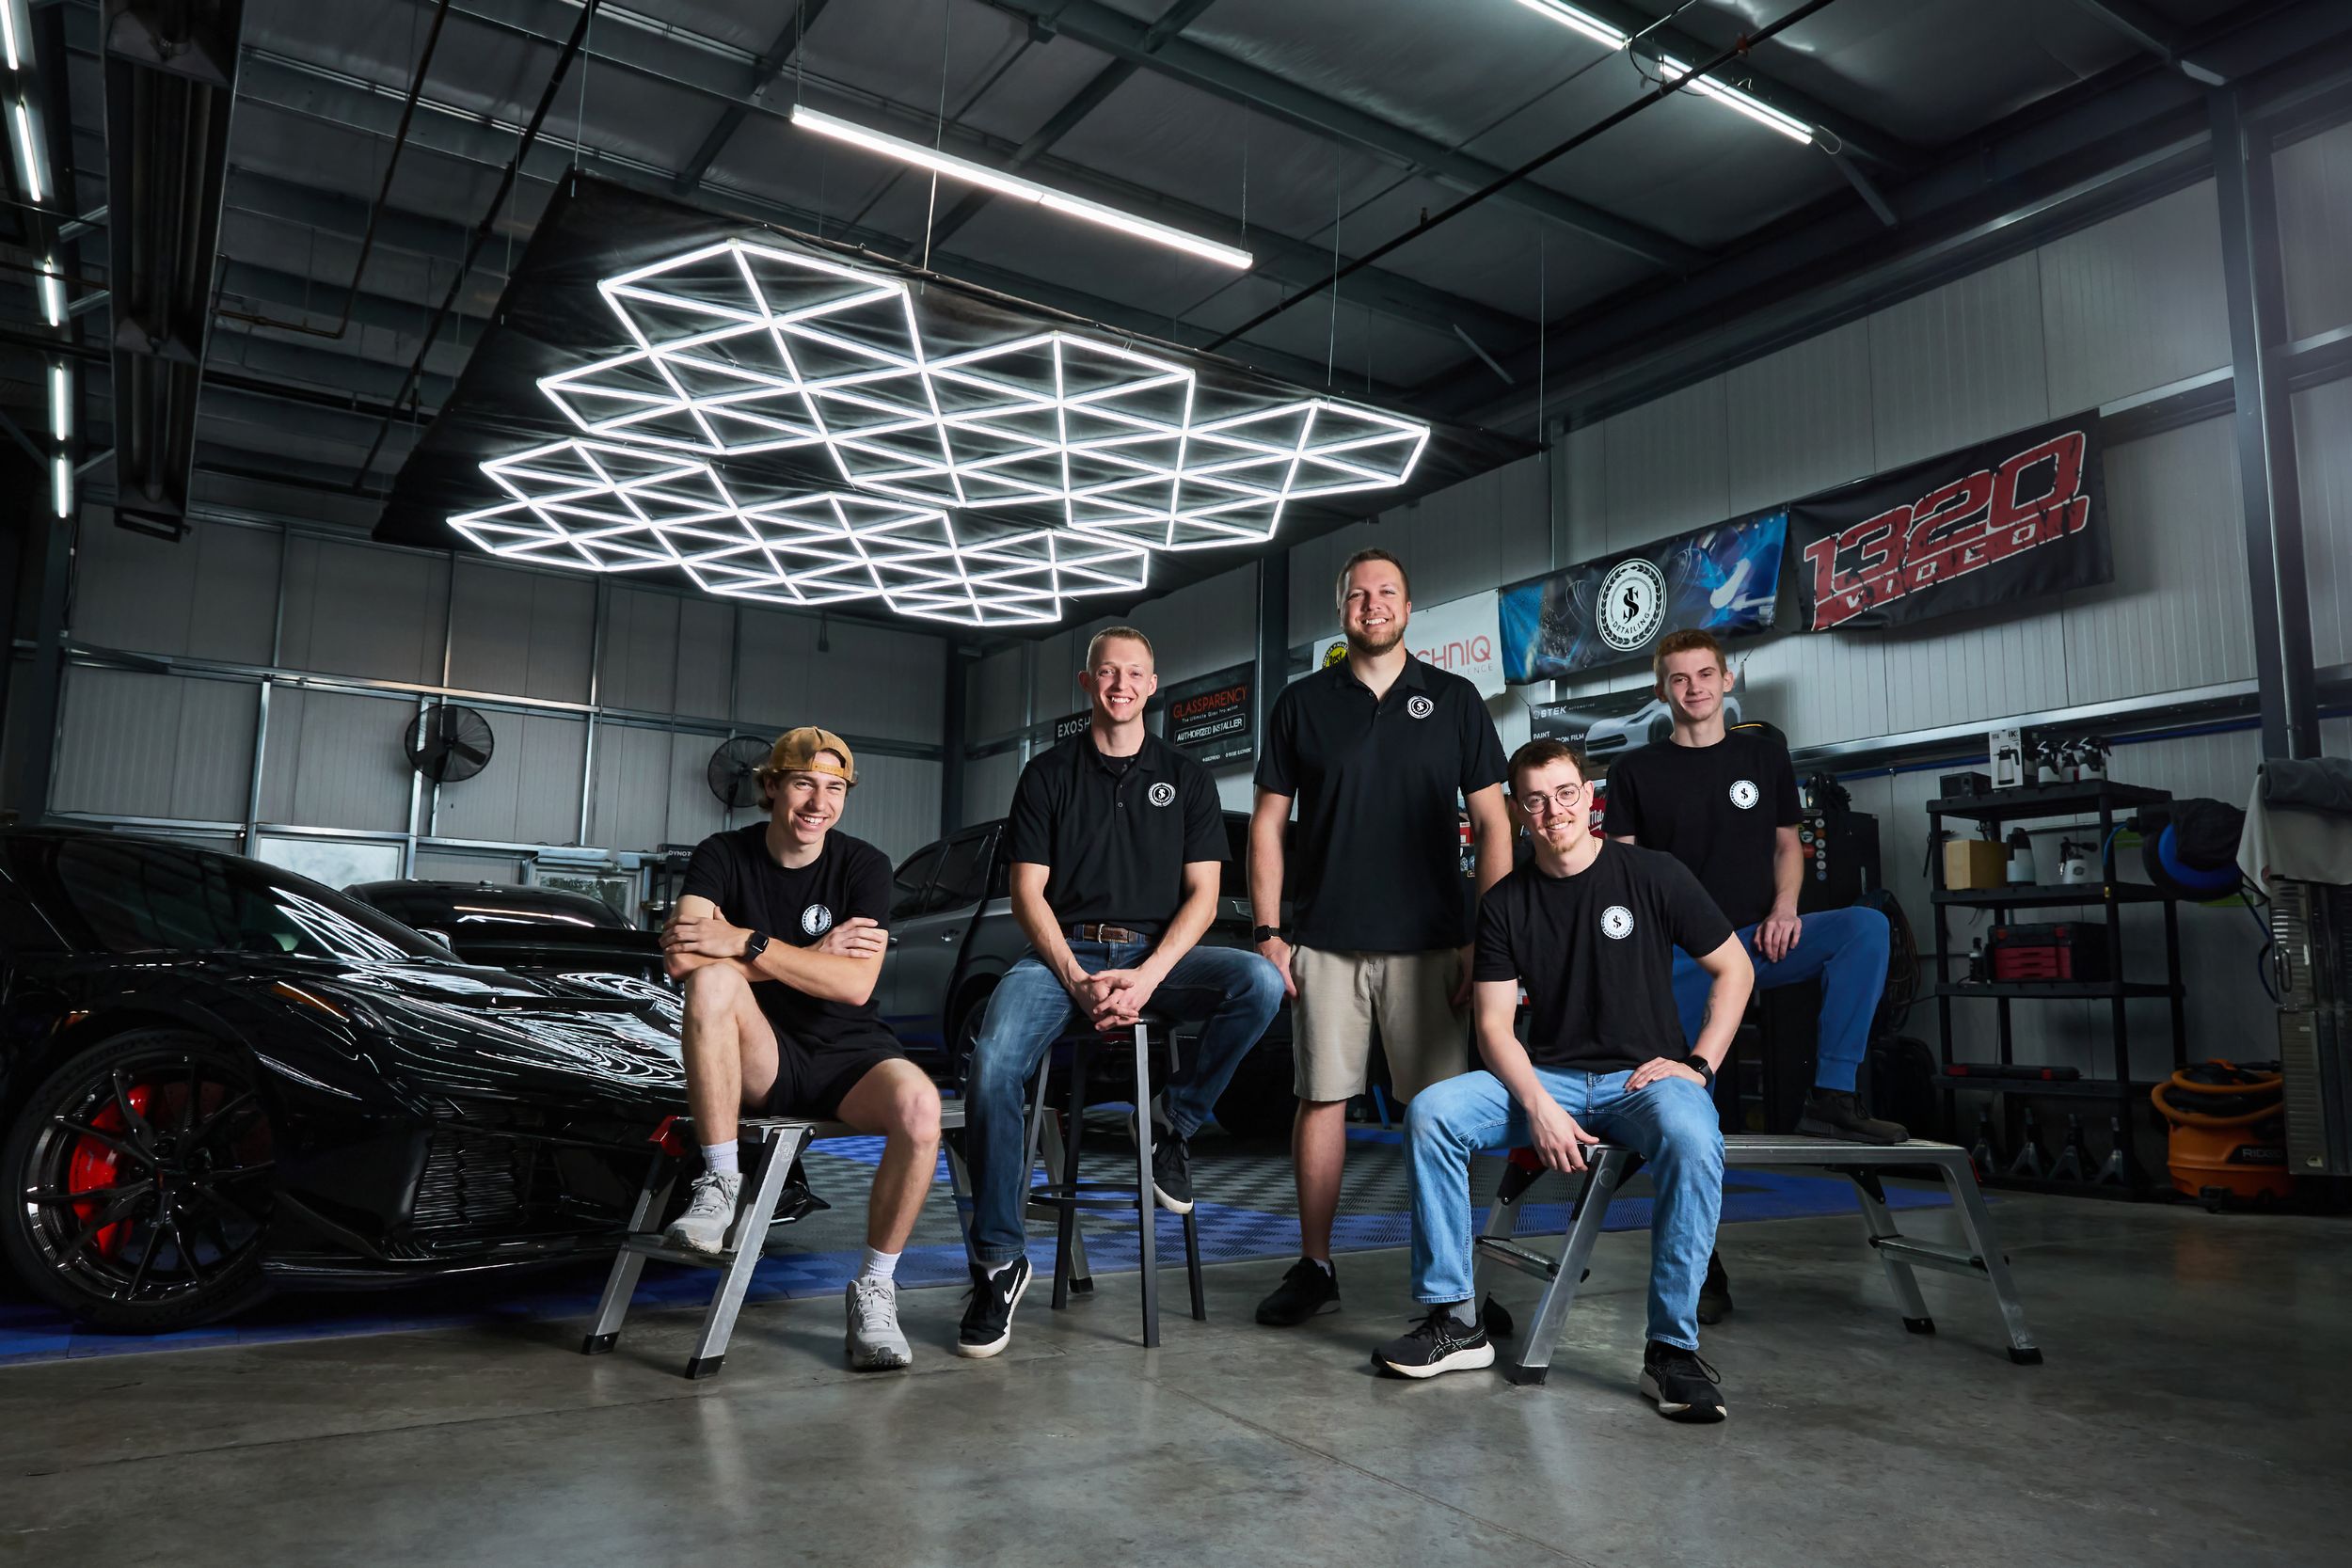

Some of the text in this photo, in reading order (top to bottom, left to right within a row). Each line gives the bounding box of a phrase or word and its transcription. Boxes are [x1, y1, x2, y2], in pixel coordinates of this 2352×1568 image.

[1804, 430, 2086, 606] 1320
[1846, 523, 2036, 610] VIDEO
[1612, 612, 1650, 635] DETAILING
[1173, 686, 1247, 719] GLASSPARENCY
[1540, 705, 1567, 718] STEK
[1176, 718, 1243, 742] AUTHORIZED INSTALLER
[1533, 731, 1550, 740] PAINT
[1570, 733, 1584, 741] FILM
